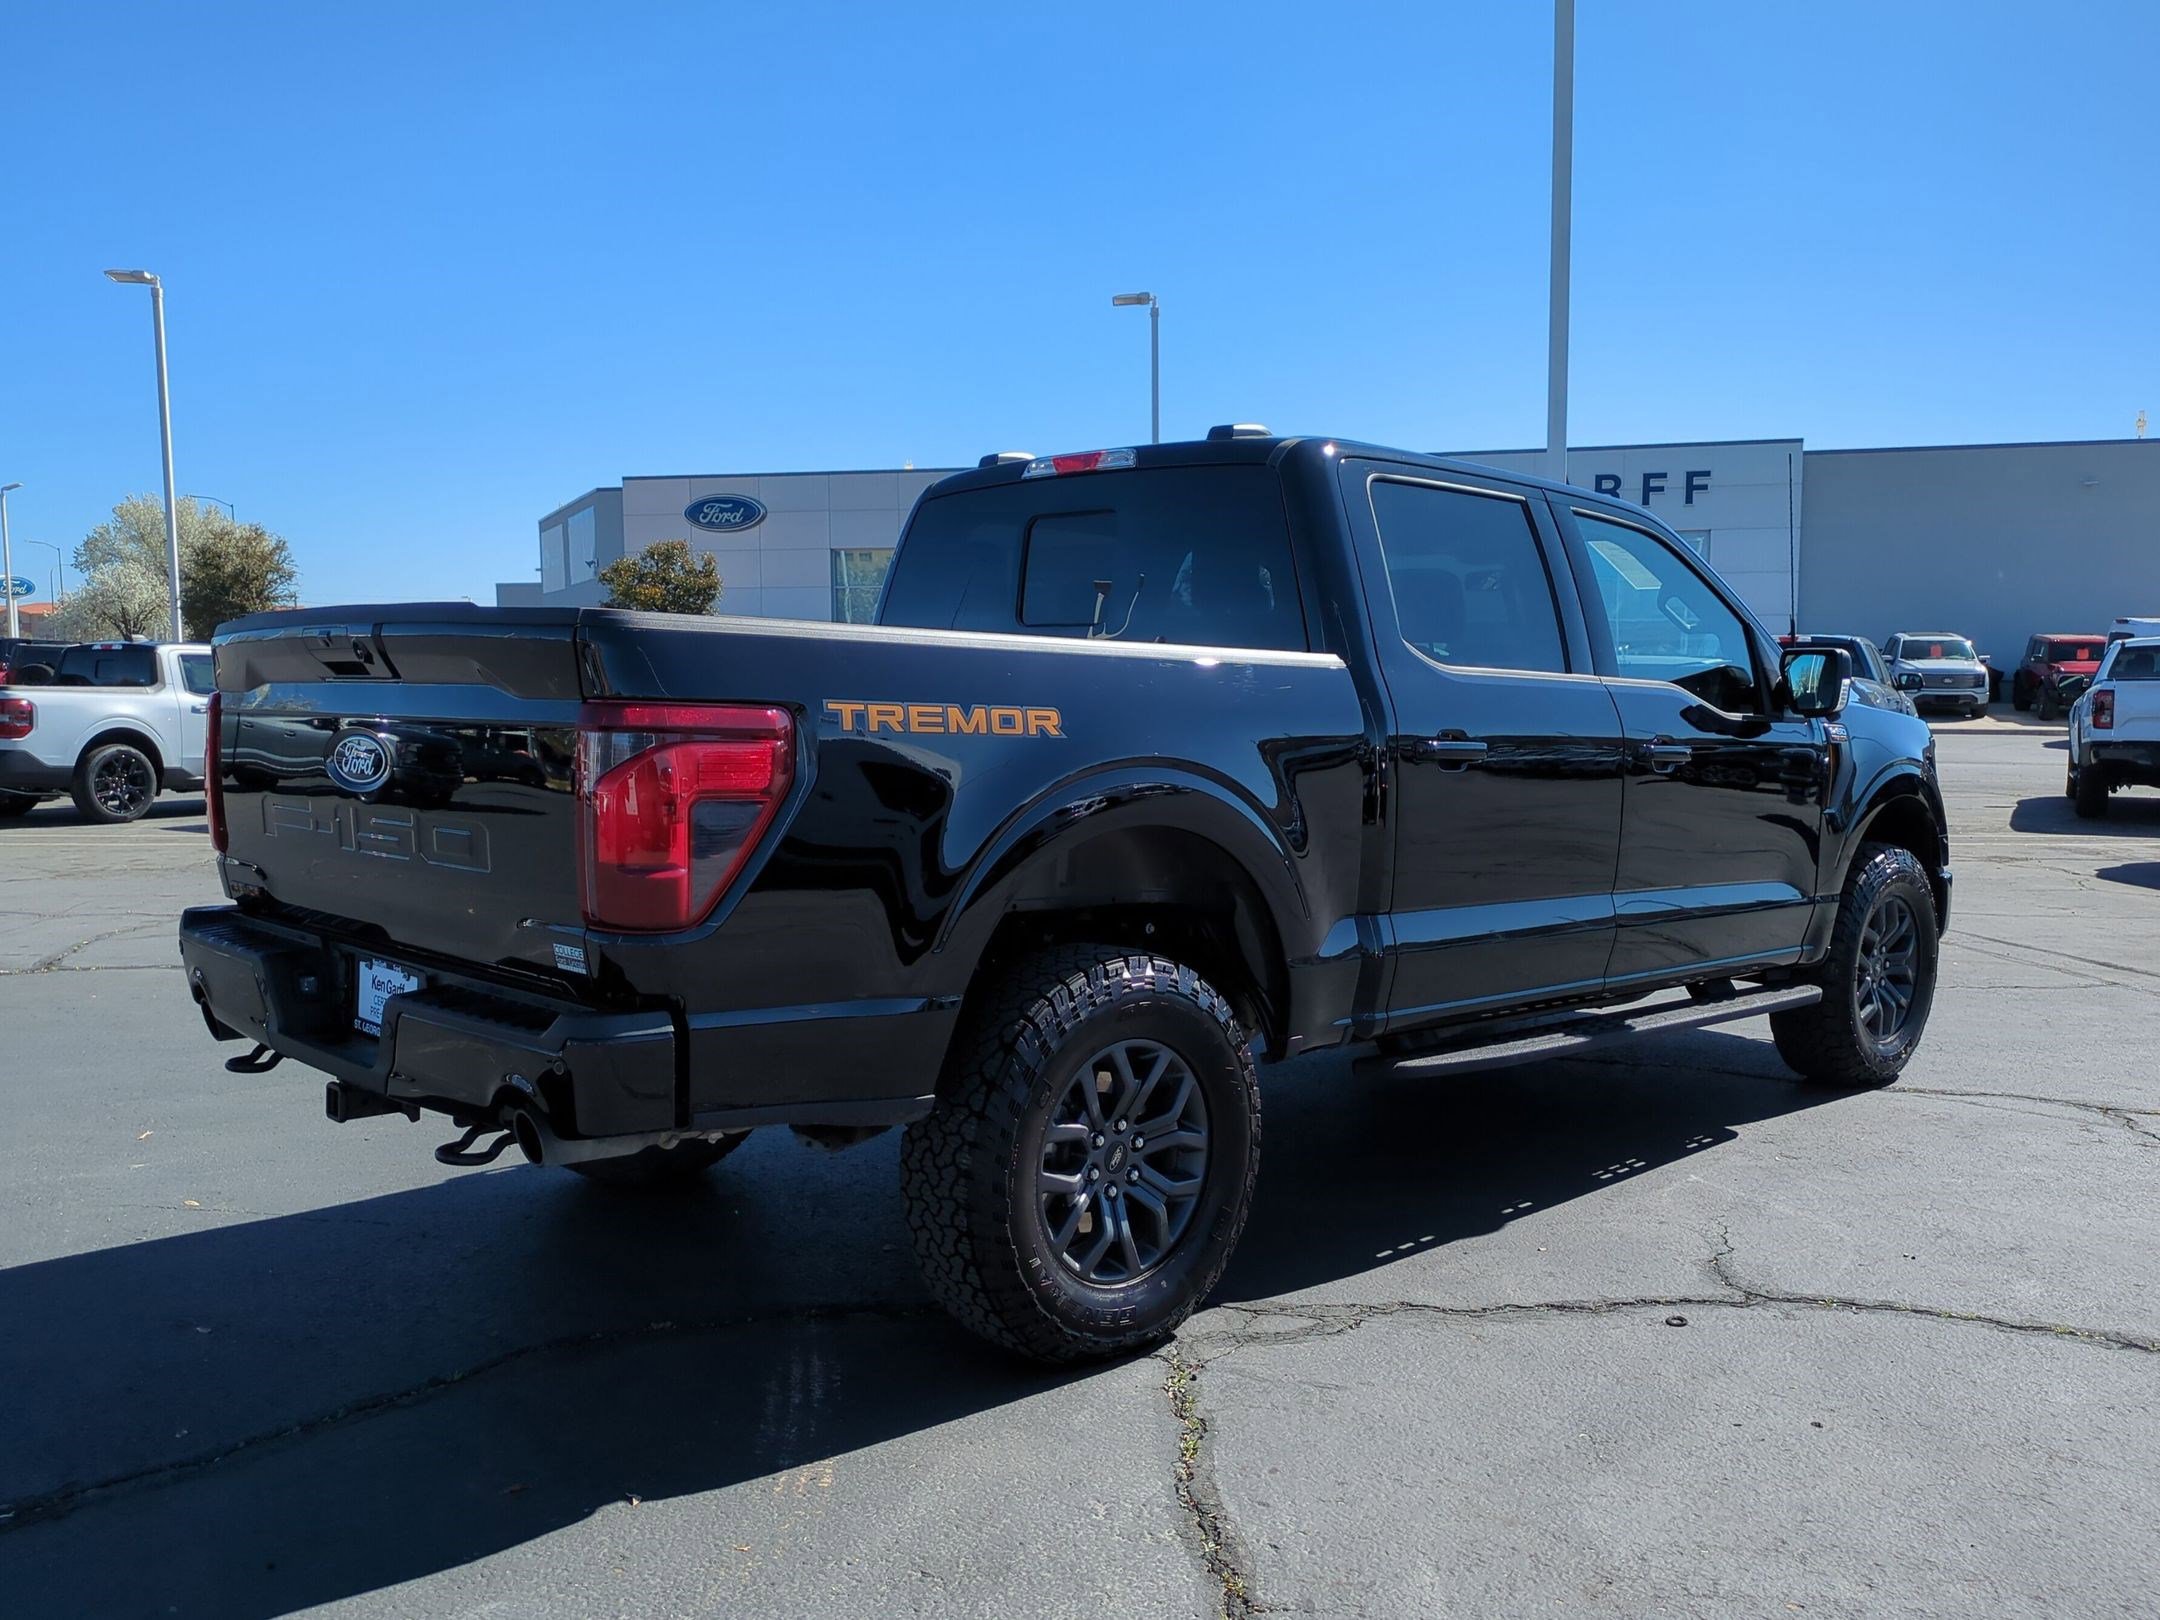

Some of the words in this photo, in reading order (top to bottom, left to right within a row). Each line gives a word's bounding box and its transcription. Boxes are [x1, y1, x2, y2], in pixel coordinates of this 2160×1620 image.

[1566, 470, 1712, 506] RFF
[699, 502, 745, 524] Ford
[826, 702, 1063, 736] TREMOR
[341, 740, 375, 777] Ford
[261, 794, 492, 873] F-150
[554, 945, 584, 960] COLLEGE
[371, 973, 386, 993] Ken
